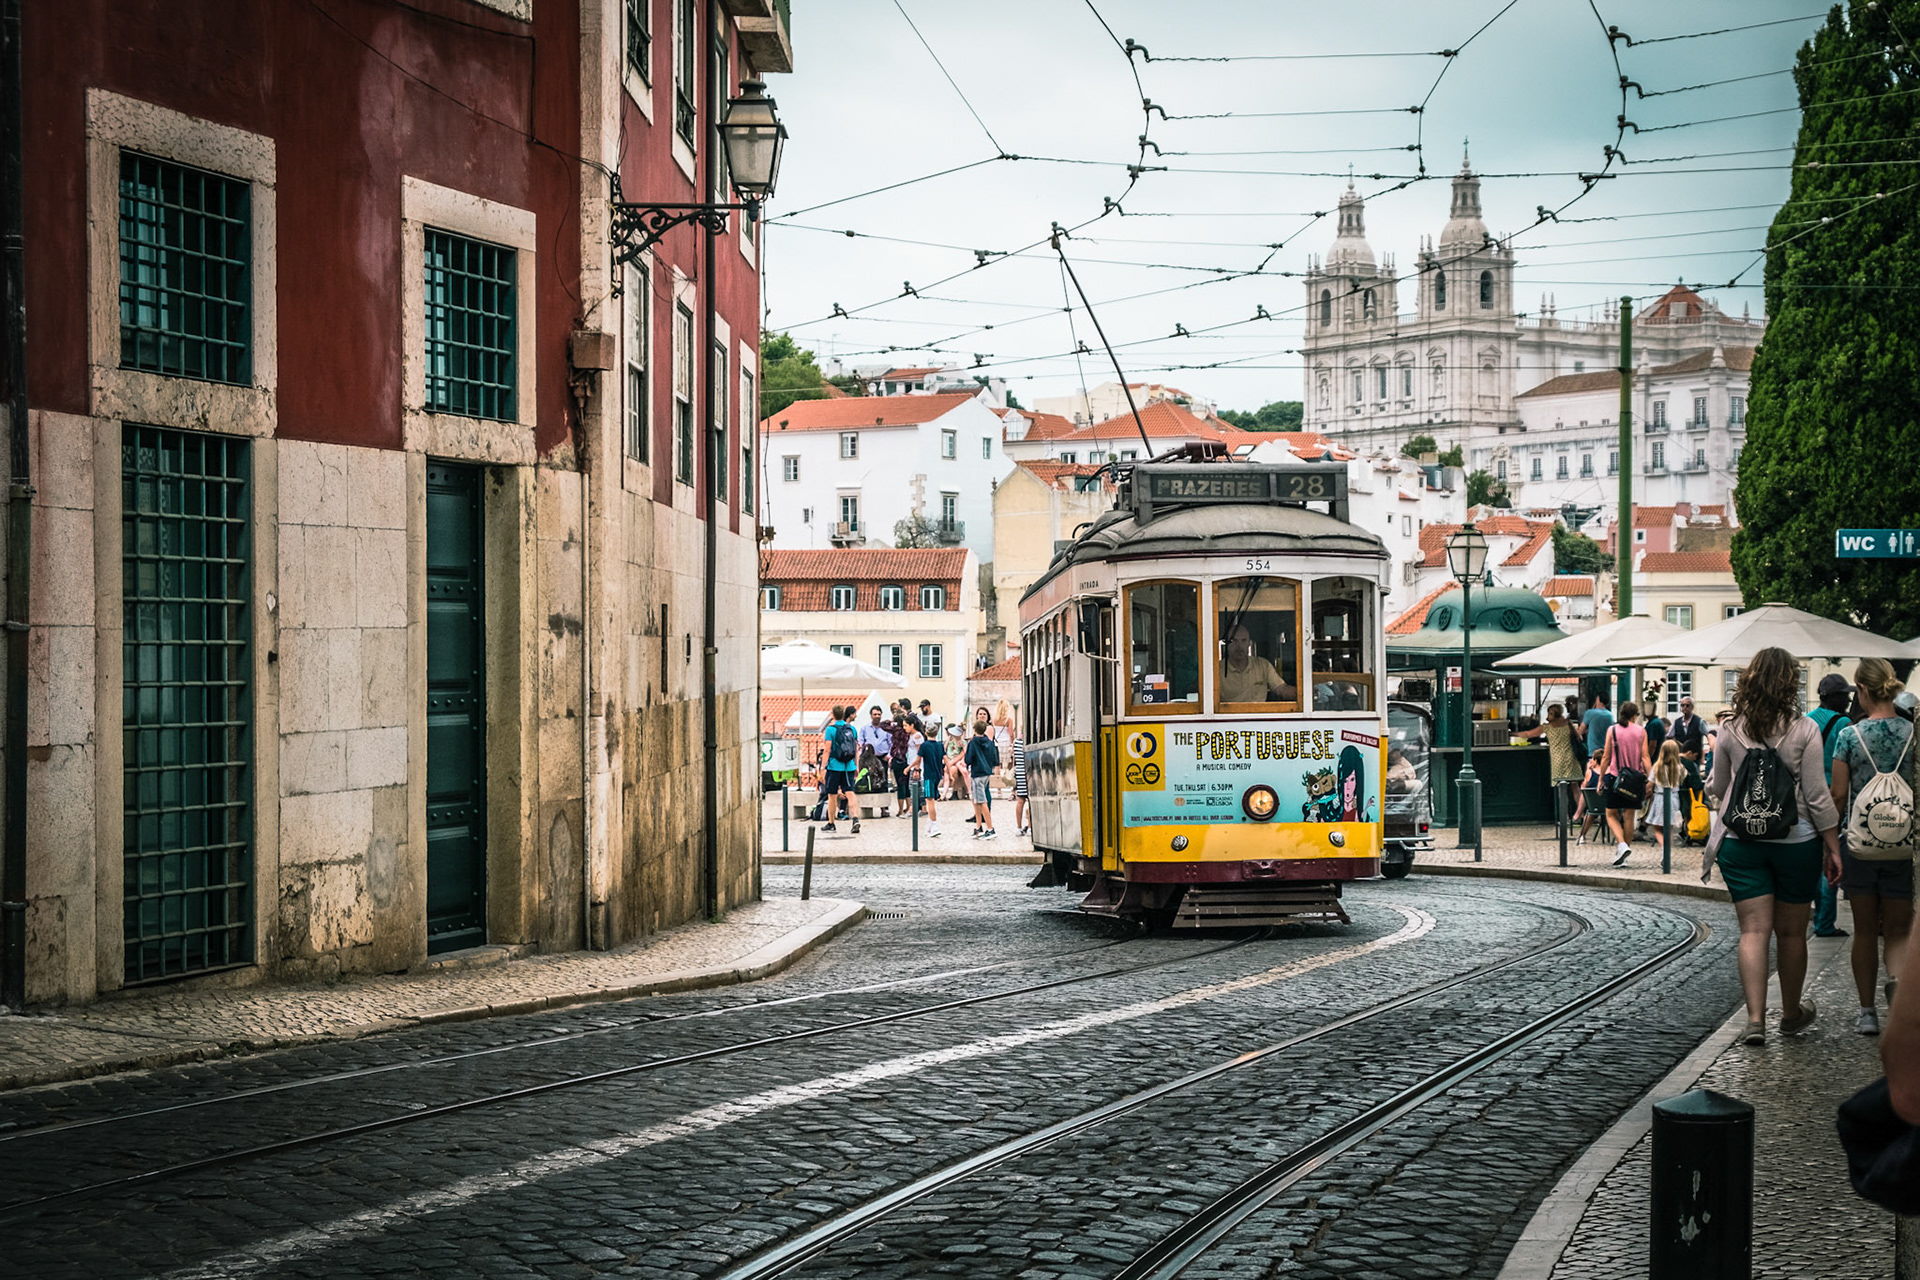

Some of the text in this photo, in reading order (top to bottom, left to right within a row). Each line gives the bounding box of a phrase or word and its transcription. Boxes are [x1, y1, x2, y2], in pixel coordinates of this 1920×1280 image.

[1157, 475, 1324, 497] PRAZERES 28
[1842, 536, 1875, 551] WC
[1246, 559, 1270, 571] 554
[1079, 580, 1099, 590] ENTRADA
[1142, 694, 1154, 702] 09
[1173, 730, 1336, 760] THE PORTUGUESE
[1196, 762, 1252, 771] A MUSICAL COMEDY
[1211, 783, 1234, 791] 6.30PM
[1873, 813, 1897, 821] Globe
